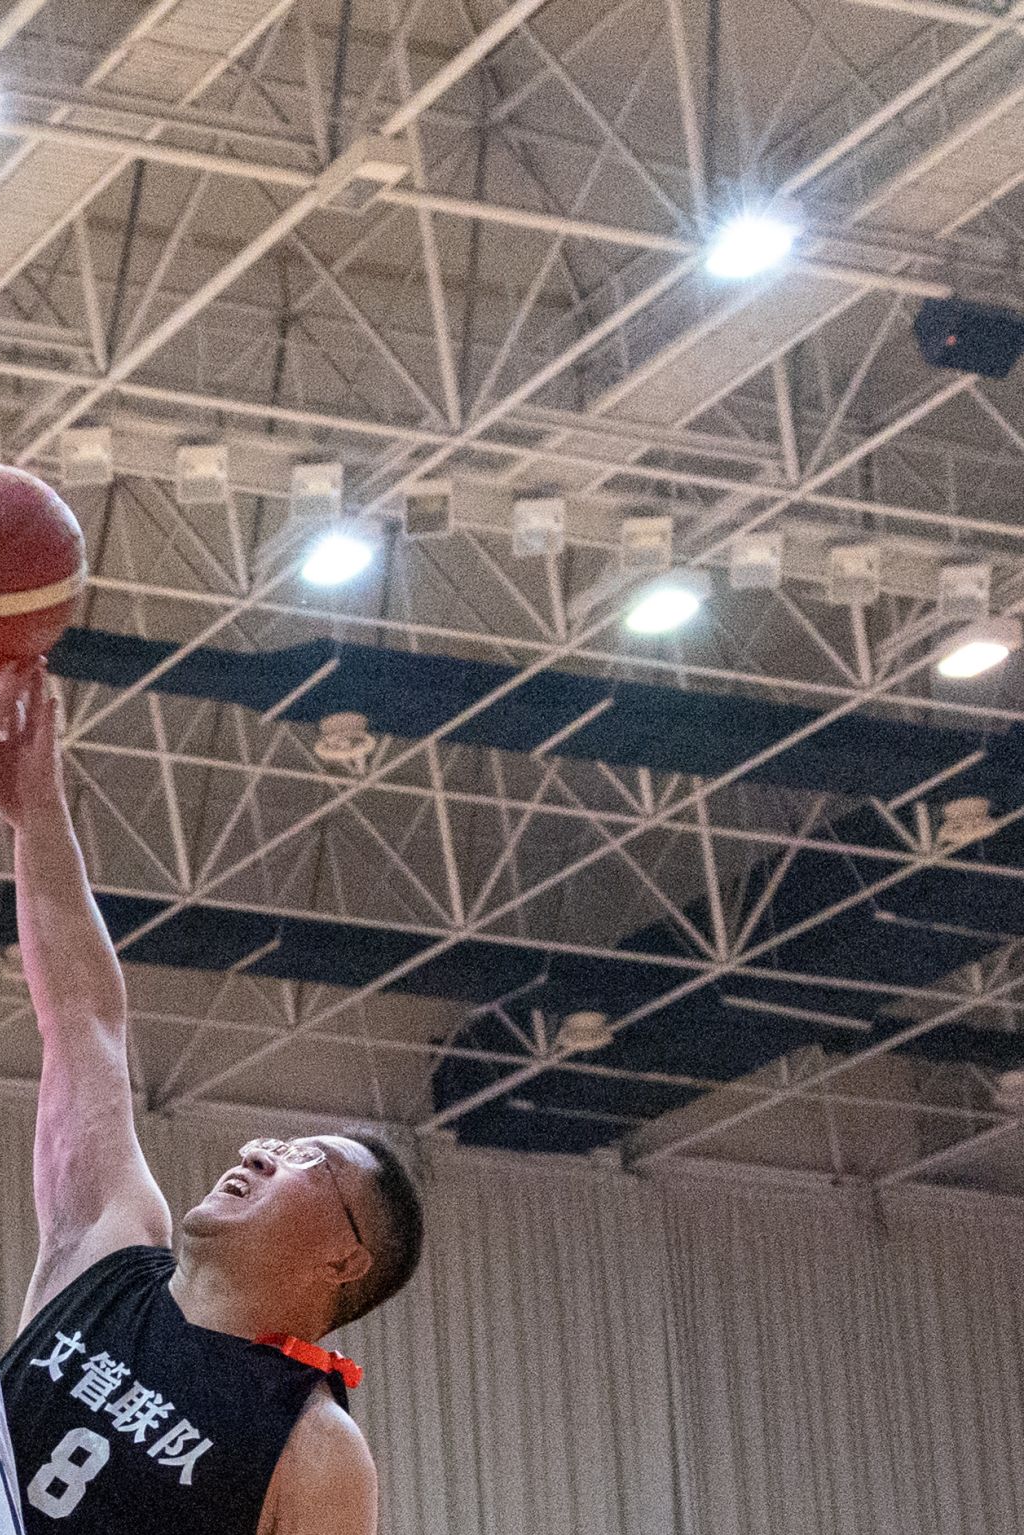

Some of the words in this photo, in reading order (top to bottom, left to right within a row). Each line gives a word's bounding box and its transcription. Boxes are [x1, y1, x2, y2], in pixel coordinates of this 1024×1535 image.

[29, 1330, 214, 1486] 文管联队
[27, 1427, 110, 1519] 8
